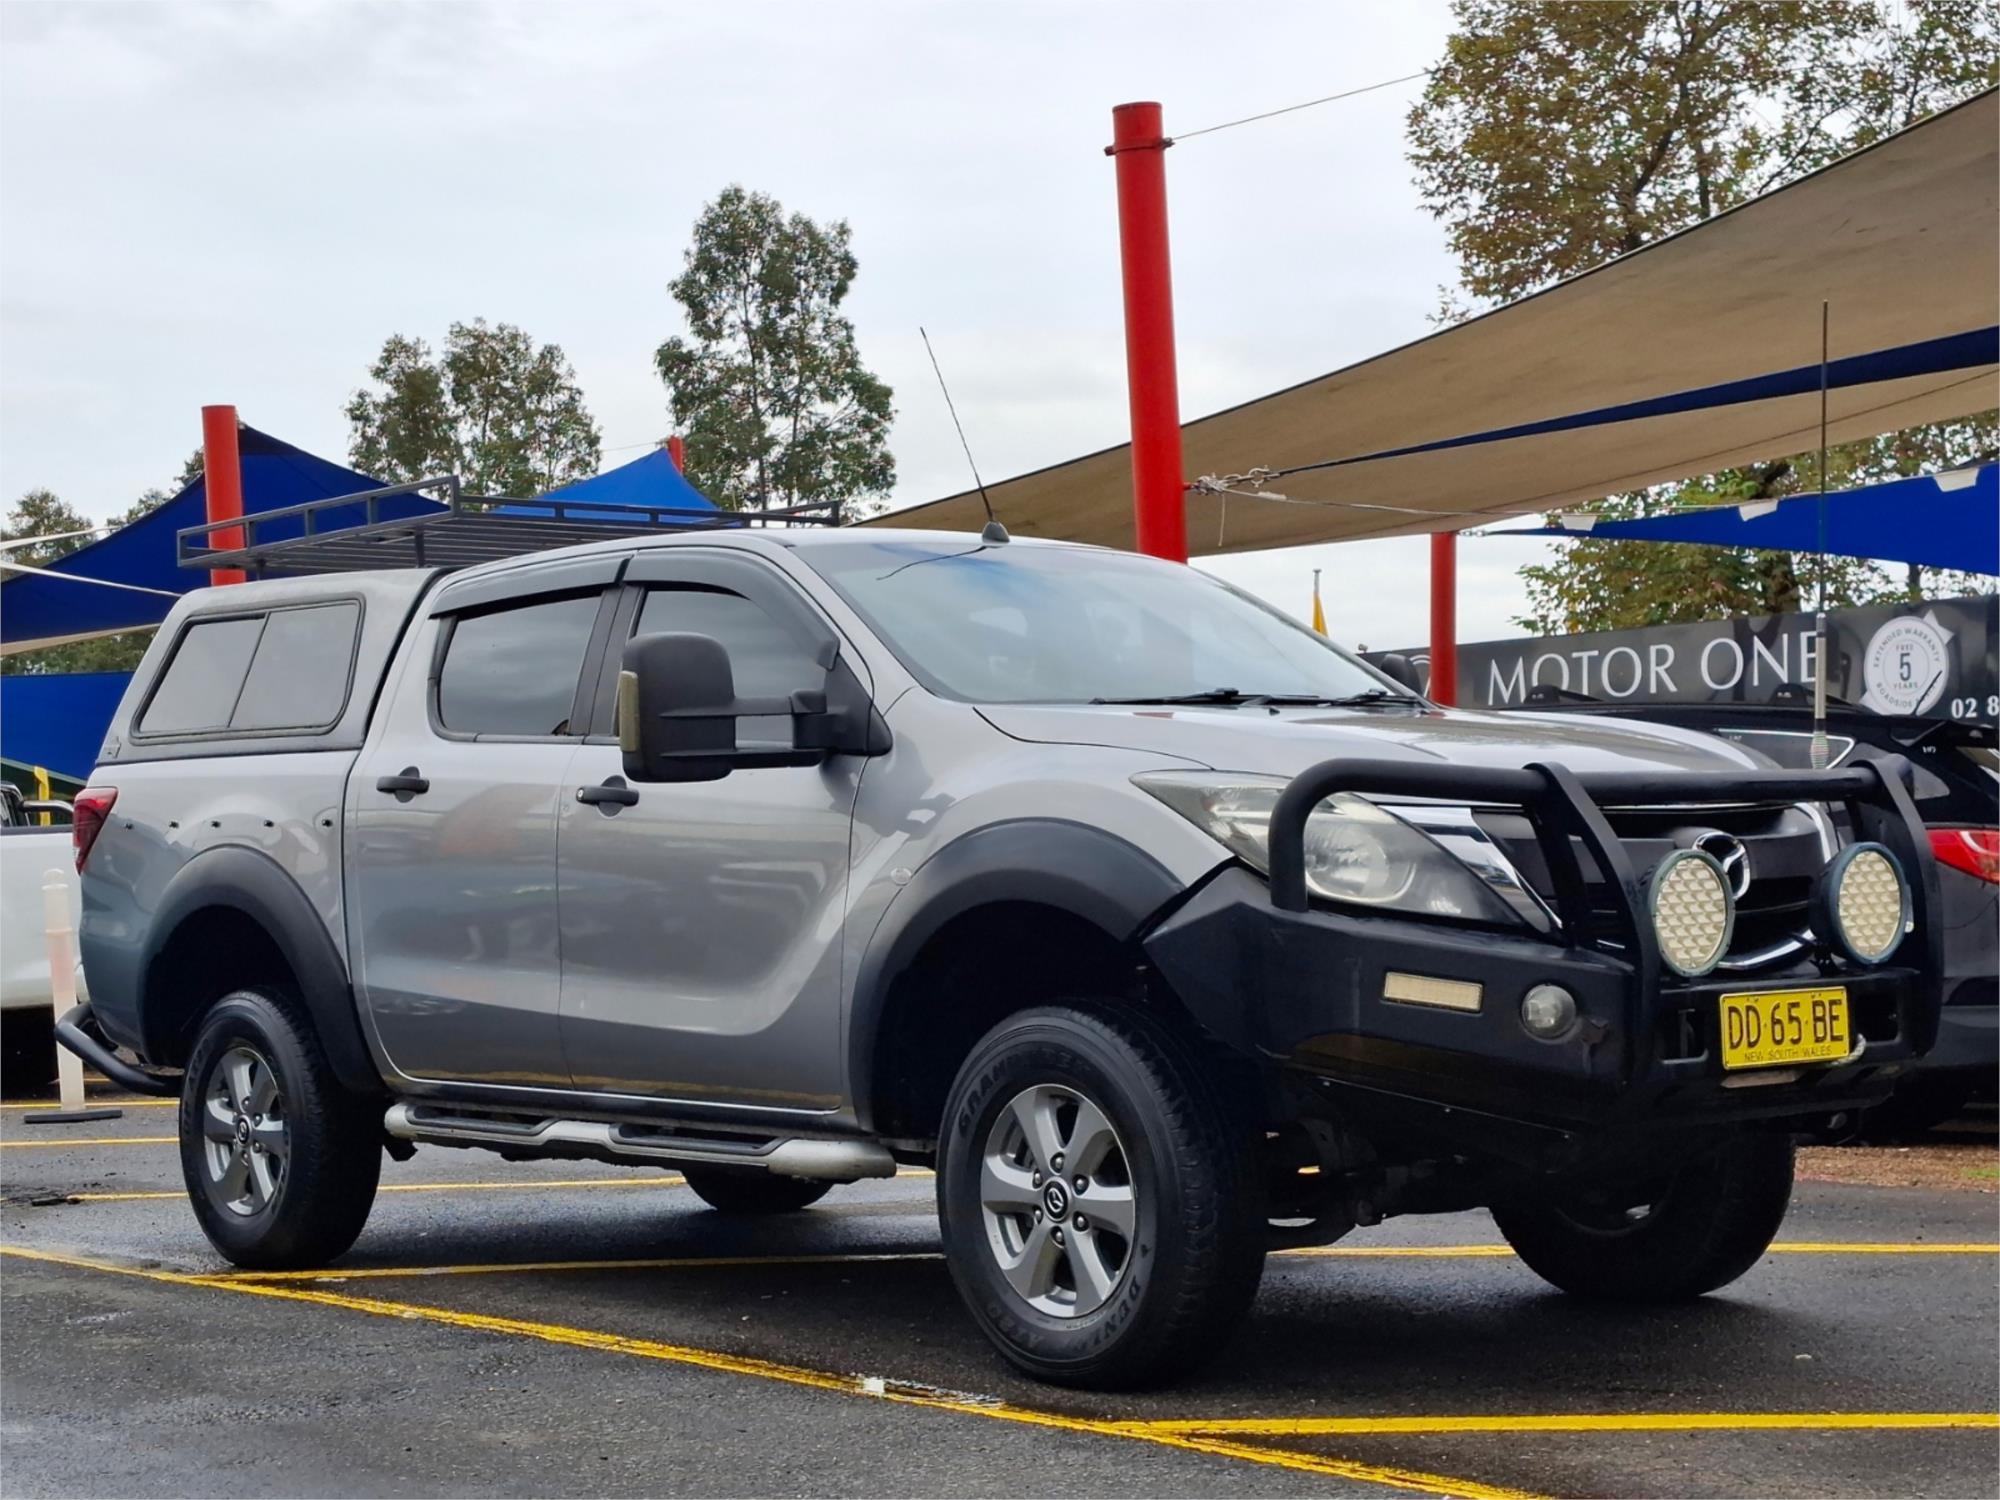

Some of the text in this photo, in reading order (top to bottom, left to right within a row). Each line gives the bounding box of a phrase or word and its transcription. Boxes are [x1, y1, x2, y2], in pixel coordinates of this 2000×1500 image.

[1904, 628, 1940, 662] WARRANTY
[1488, 630, 1817, 706] MOTOR ONE
[1899, 652, 1911, 681] 5
[1893, 681, 1918, 689] YEARS
[1951, 697, 1978, 718] 02
[1727, 998, 1844, 1050] DD 65 BE
[1744, 1045, 1833, 1061] NEW SOUTH WALES
